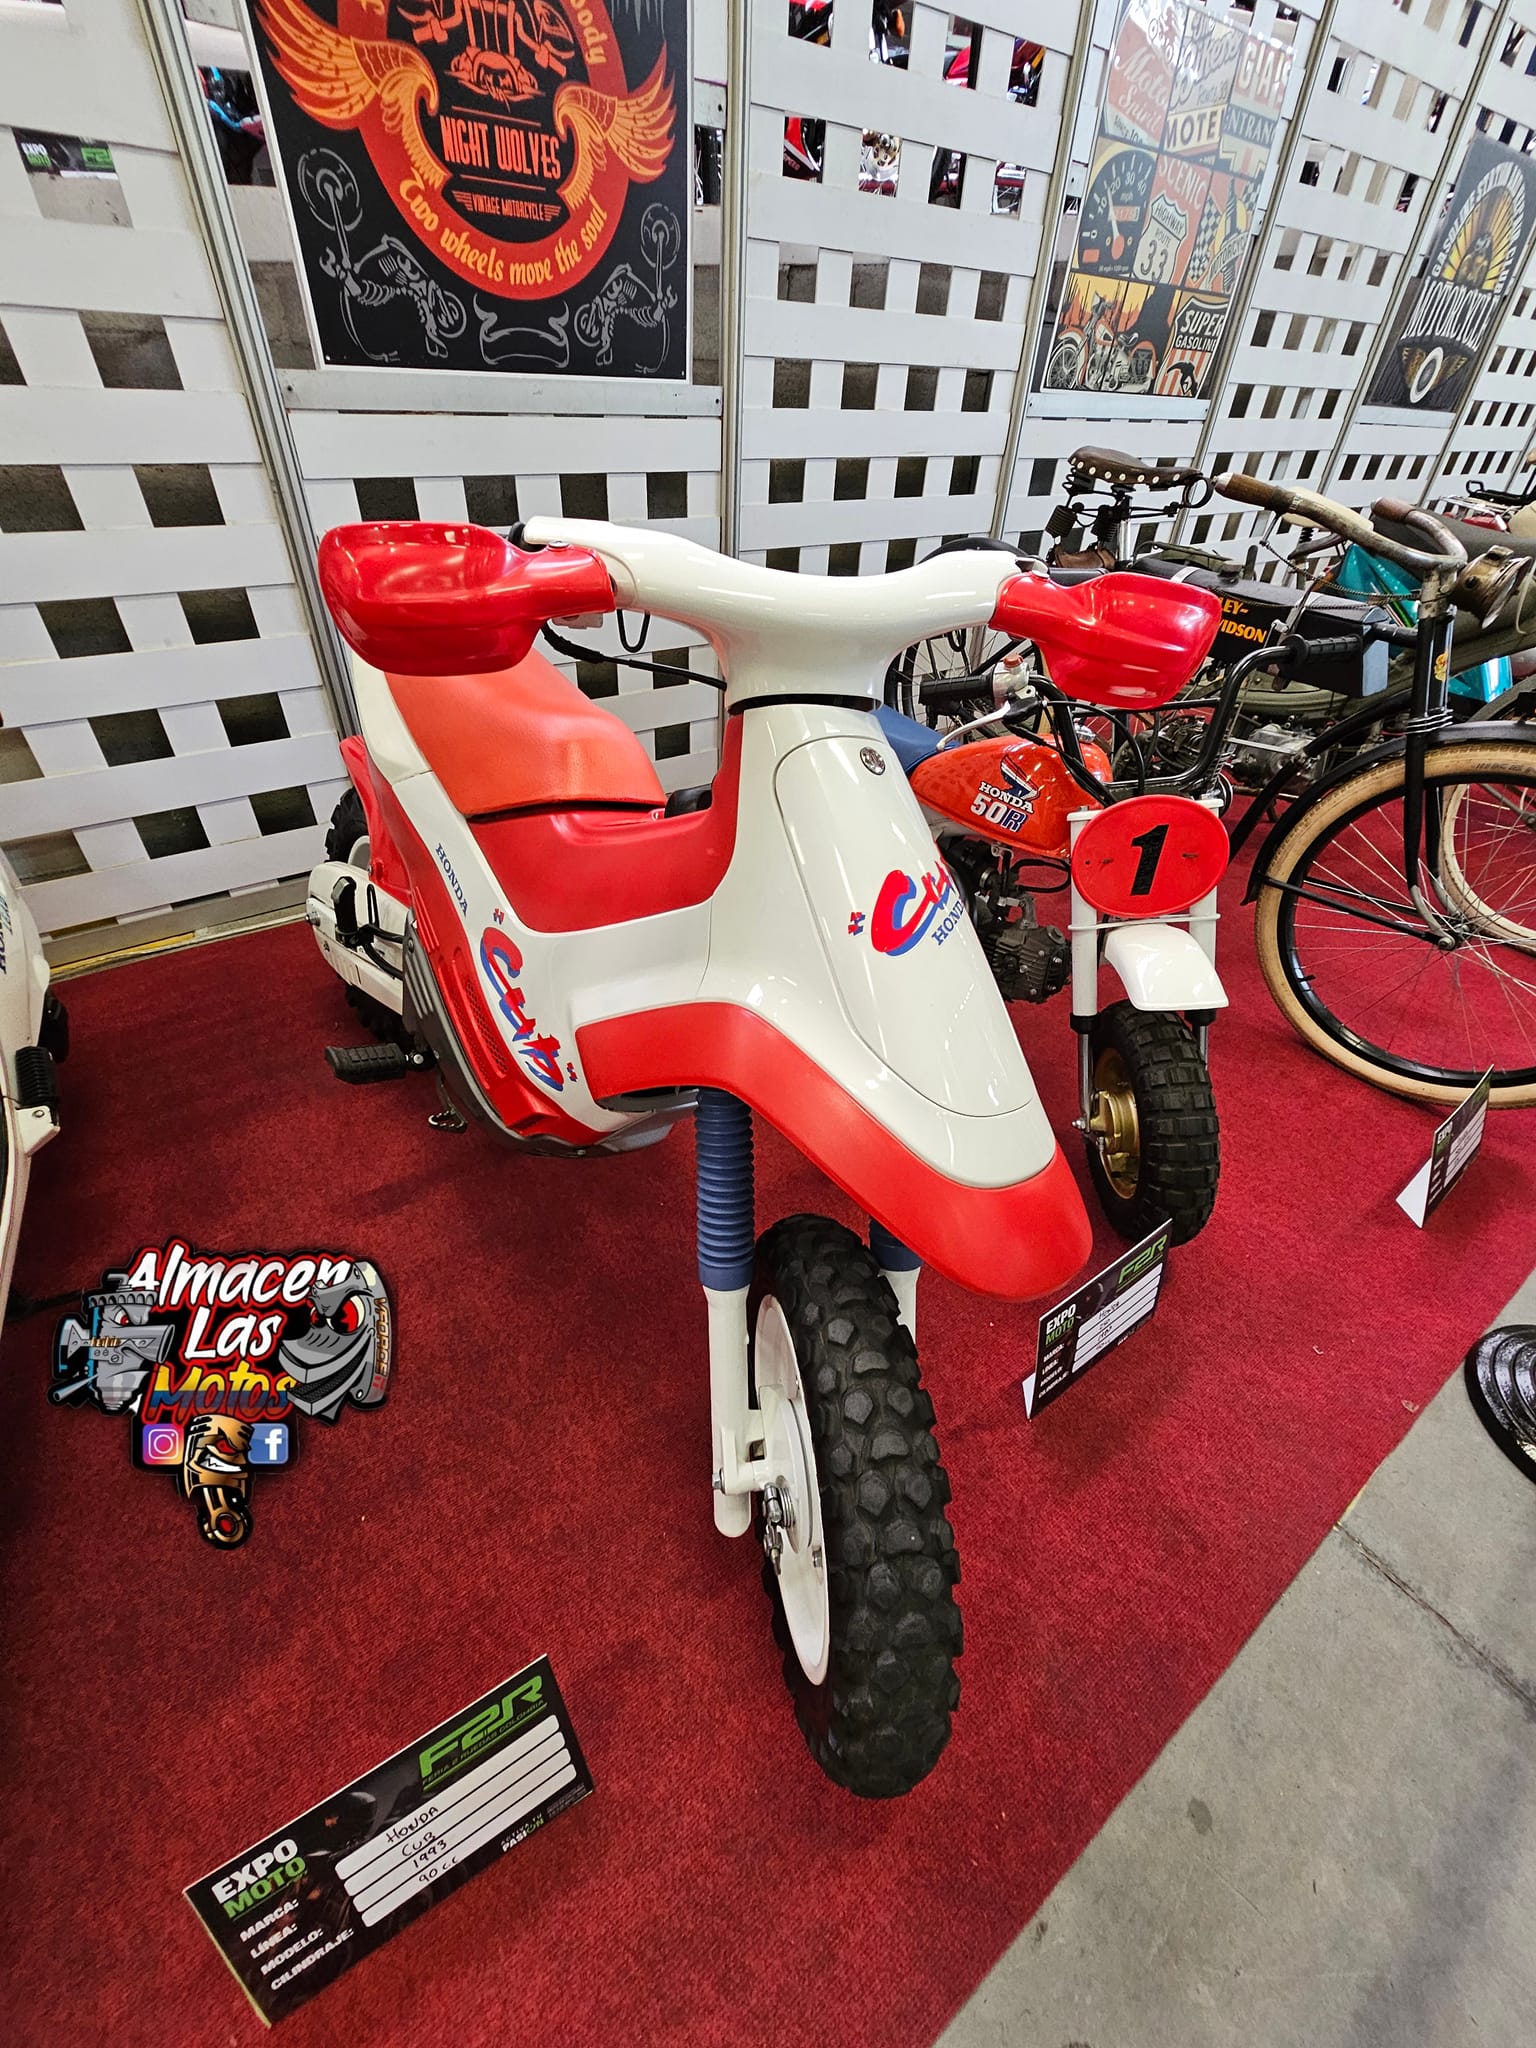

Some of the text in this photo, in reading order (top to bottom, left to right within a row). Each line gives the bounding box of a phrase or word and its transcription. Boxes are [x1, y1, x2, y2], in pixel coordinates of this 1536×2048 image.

[440, 115, 561, 180] NIGHT WOLVES
[472, 192, 544, 221] VINTAGE MOTORCYCLE
[1158, 155, 1209, 210] SCENIC
[400, 167, 607, 286] Two wheels move the soul
[1155, 205, 1185, 236] HIGHWAY
[1401, 275, 1500, 352] MOTORCYCLE
[970, 794, 1028, 832] 50R
[978, 781, 1034, 814] HONDA
[436, 843, 468, 917] HONDA
[1130, 824, 1169, 896] 1
[931, 900, 965, 946] HOND
[1118, 1234, 1168, 1284] F2R
[1045, 1316, 1075, 1345] MOTO
[1046, 1304, 1076, 1334] EXPO
[419, 1675, 543, 1779] F2R
[422, 1766, 450, 1786] FERIA
[460, 1730, 498, 1760] RUEDAS
[386, 1806, 438, 1843] HONDA
[211, 1839, 298, 1905] EXPO
[413, 1839, 447, 1868] 1993
[223, 1857, 306, 1918] MOTO
[240, 1899, 299, 1943] MARCA:
[260, 1928, 324, 1976] MODELO:
[271, 1928, 354, 1990] CILINDRAJE:
